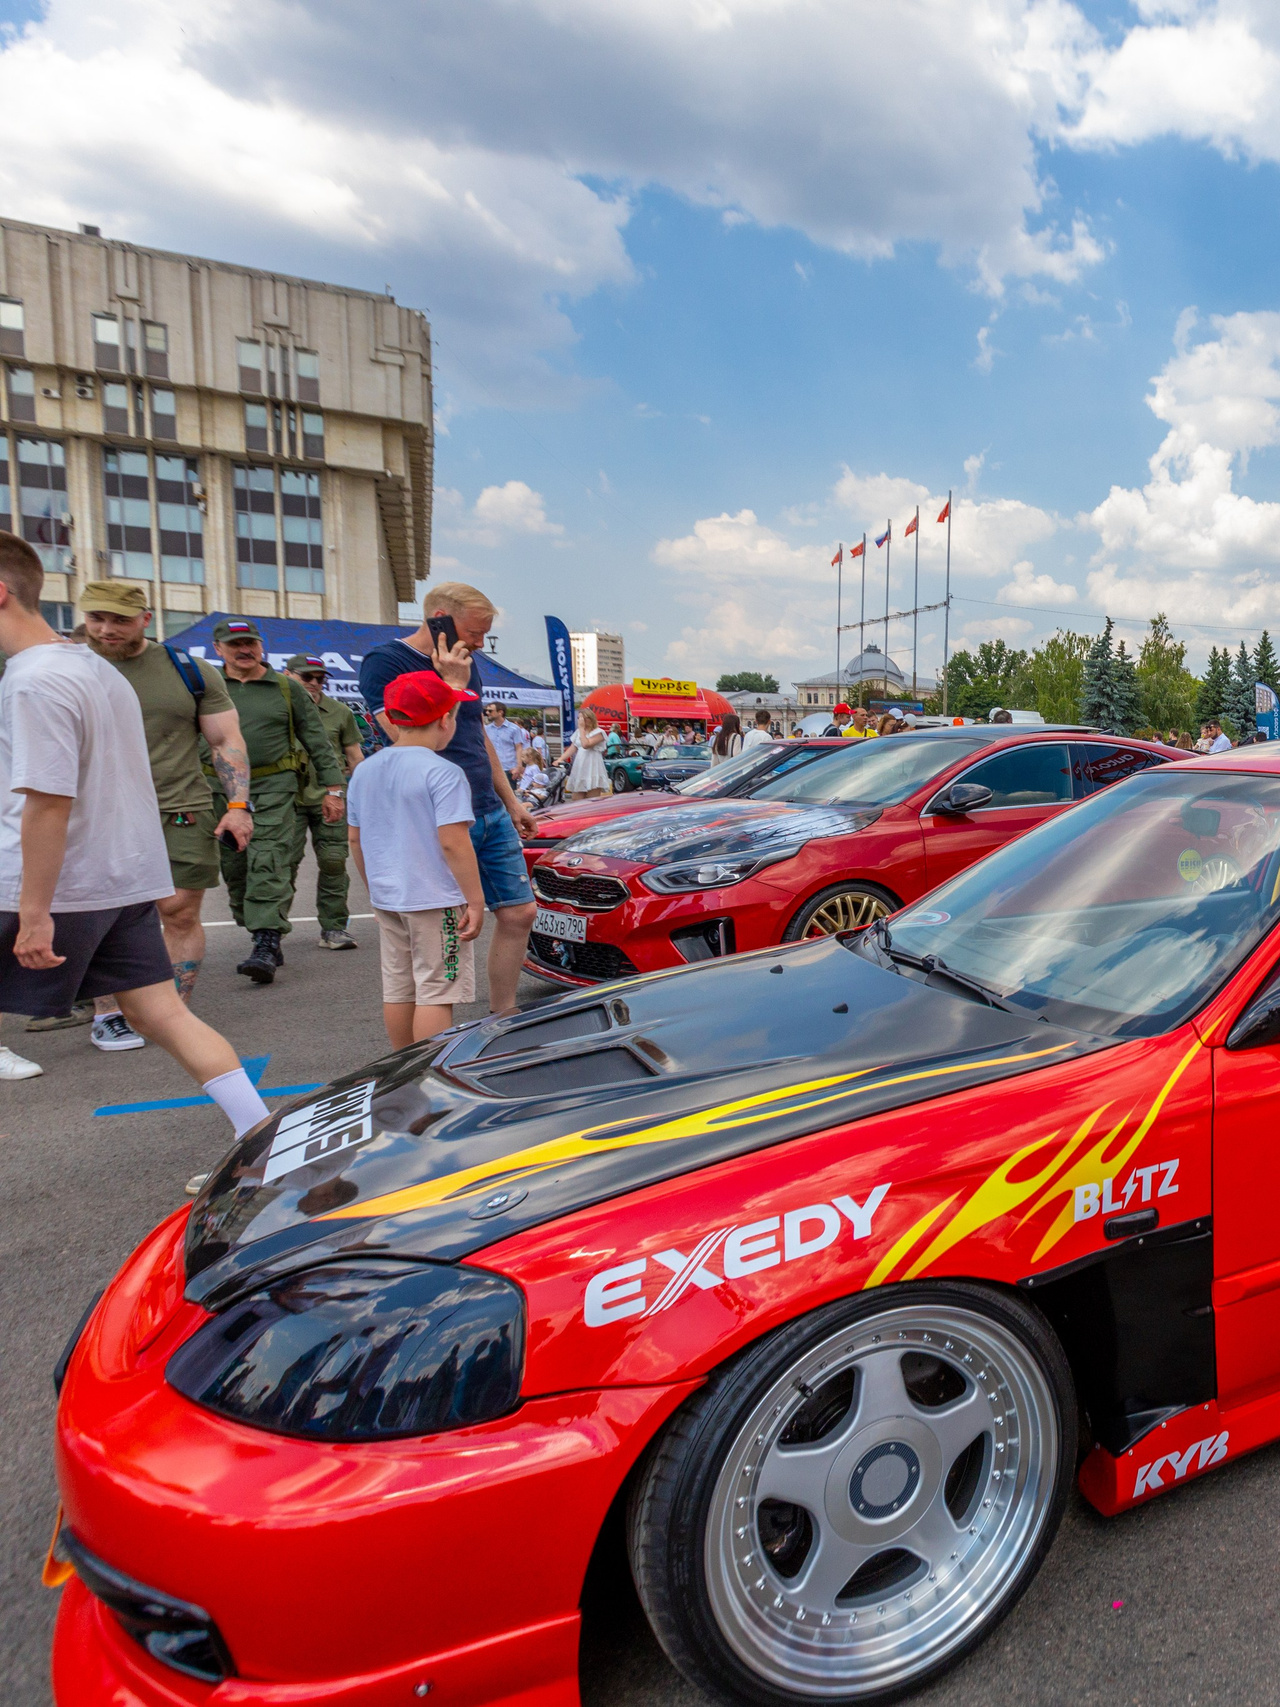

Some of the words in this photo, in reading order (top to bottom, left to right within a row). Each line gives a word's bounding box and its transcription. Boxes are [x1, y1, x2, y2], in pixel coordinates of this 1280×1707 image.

[555, 638, 572, 722] LERATON
[567, 918, 583, 934] 790
[1073, 1158, 1180, 1223] BLITZ
[583, 1182, 892, 1328] EXEDY
[1133, 1430, 1229, 1498] KYB
